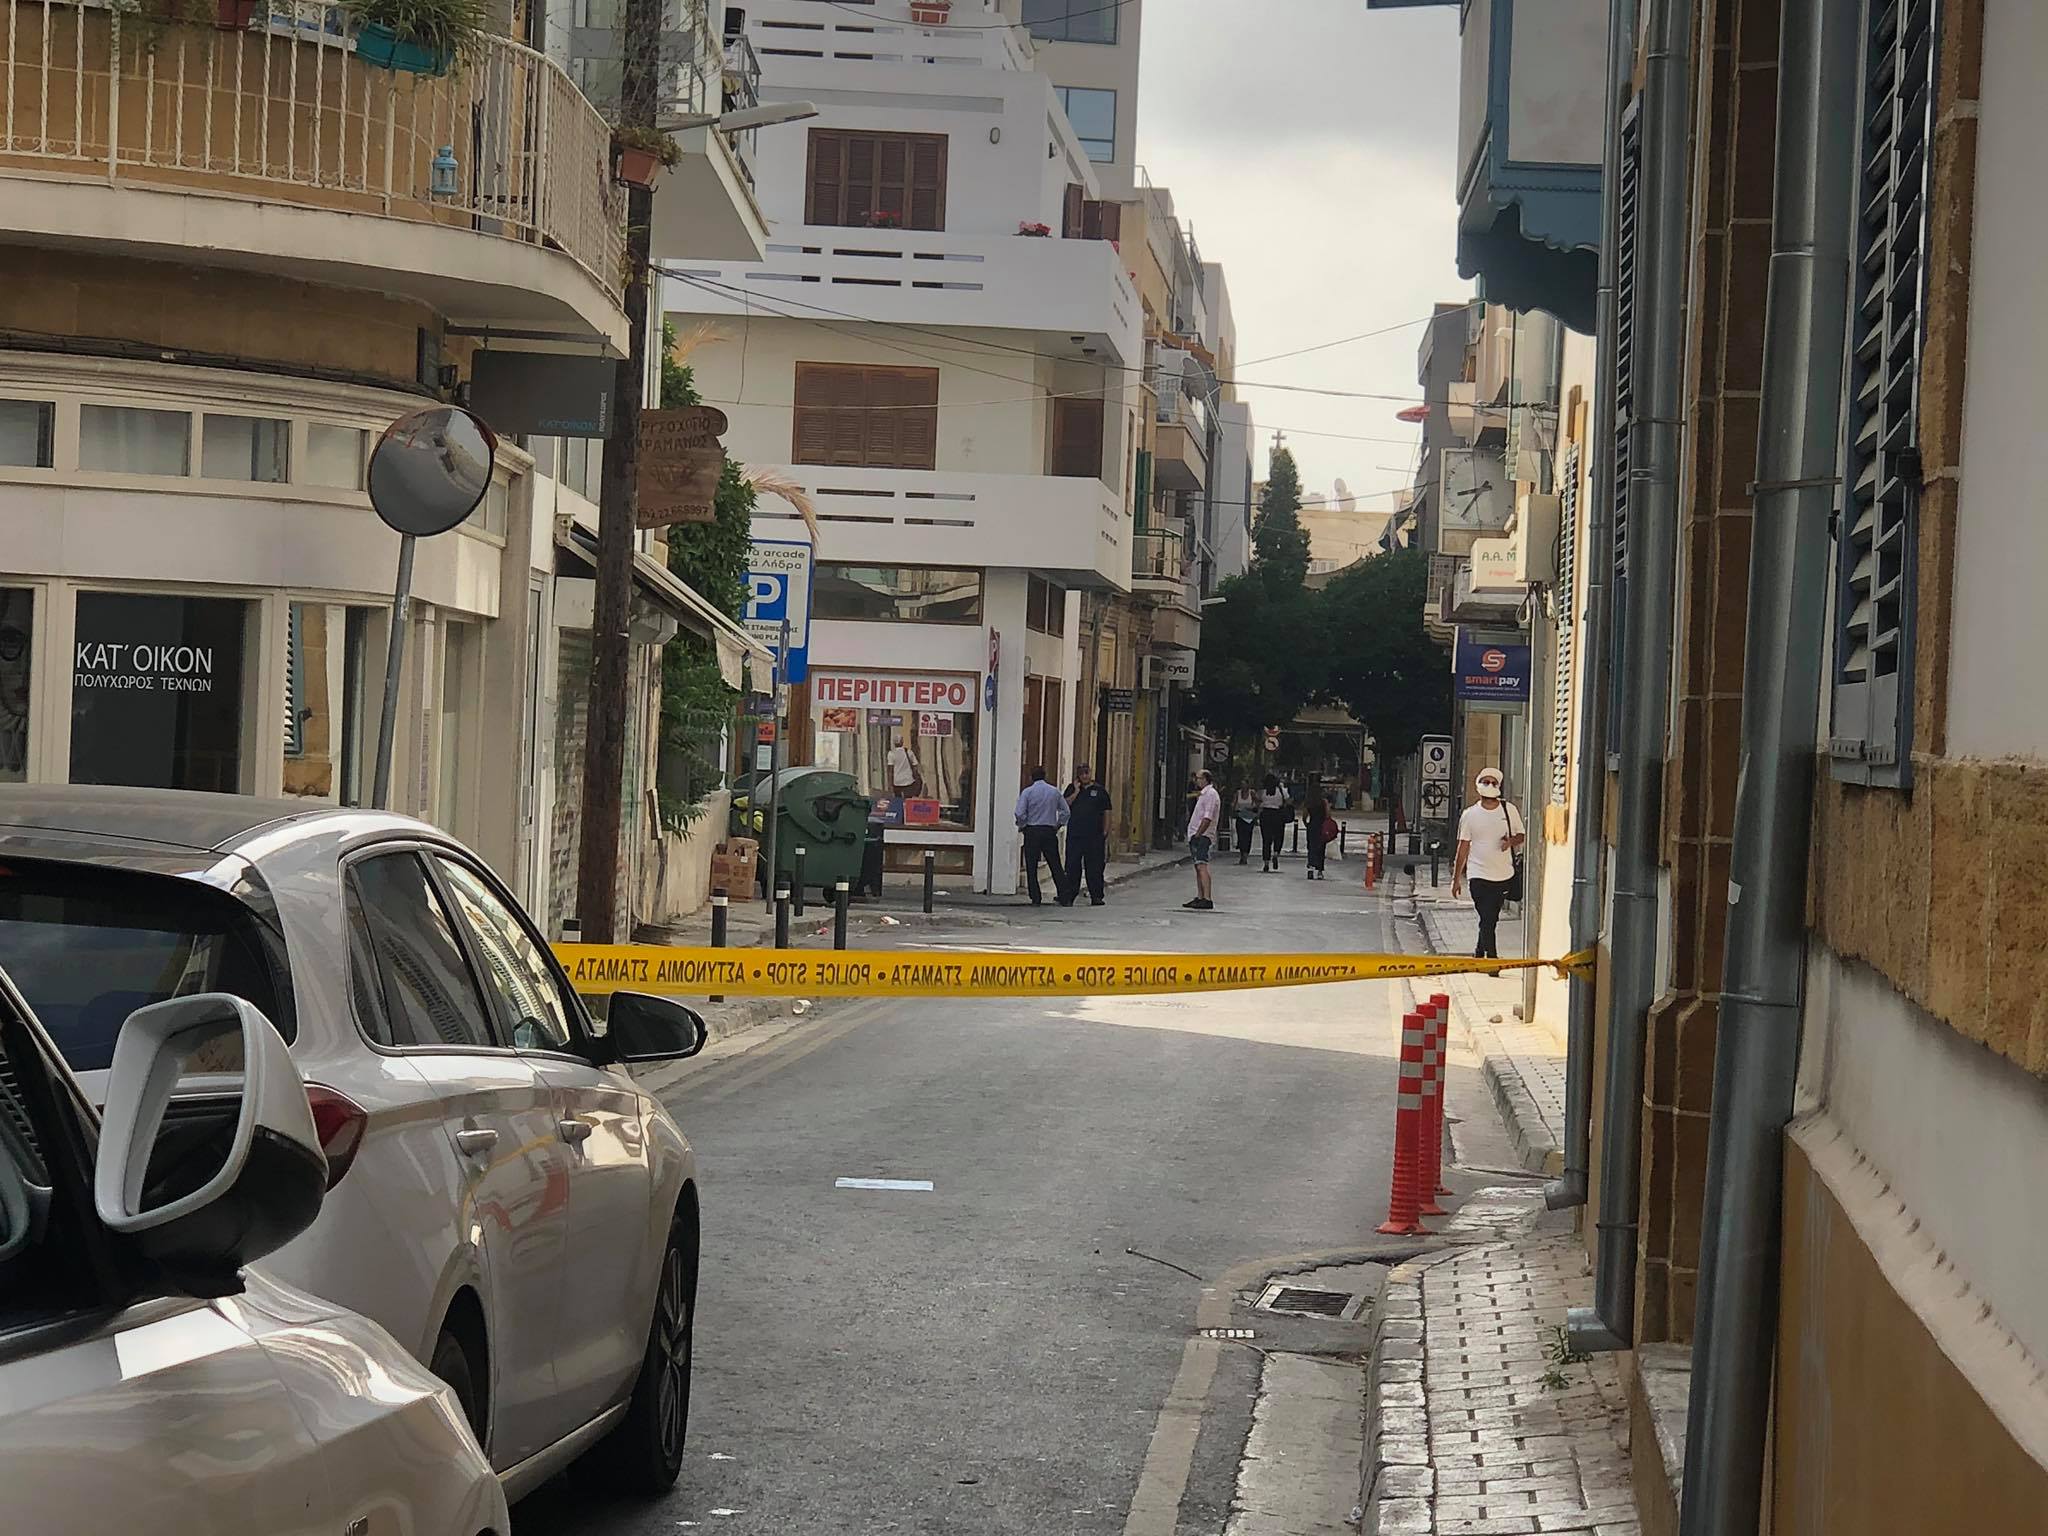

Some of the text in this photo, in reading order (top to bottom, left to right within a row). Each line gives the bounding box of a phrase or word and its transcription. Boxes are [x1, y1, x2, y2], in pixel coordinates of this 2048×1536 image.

[764, 550, 806, 559] arcade
[133, 644, 213, 674] ΟΙΚΟΝ
[1167, 664, 1190, 675] cyta
[74, 673, 212, 692] ΠΟΛΥΧΩΡΟΣ ΤΕΧΝΩΝ
[818, 677, 967, 706] ΠΕΡΙΠΤΕΡΟ
